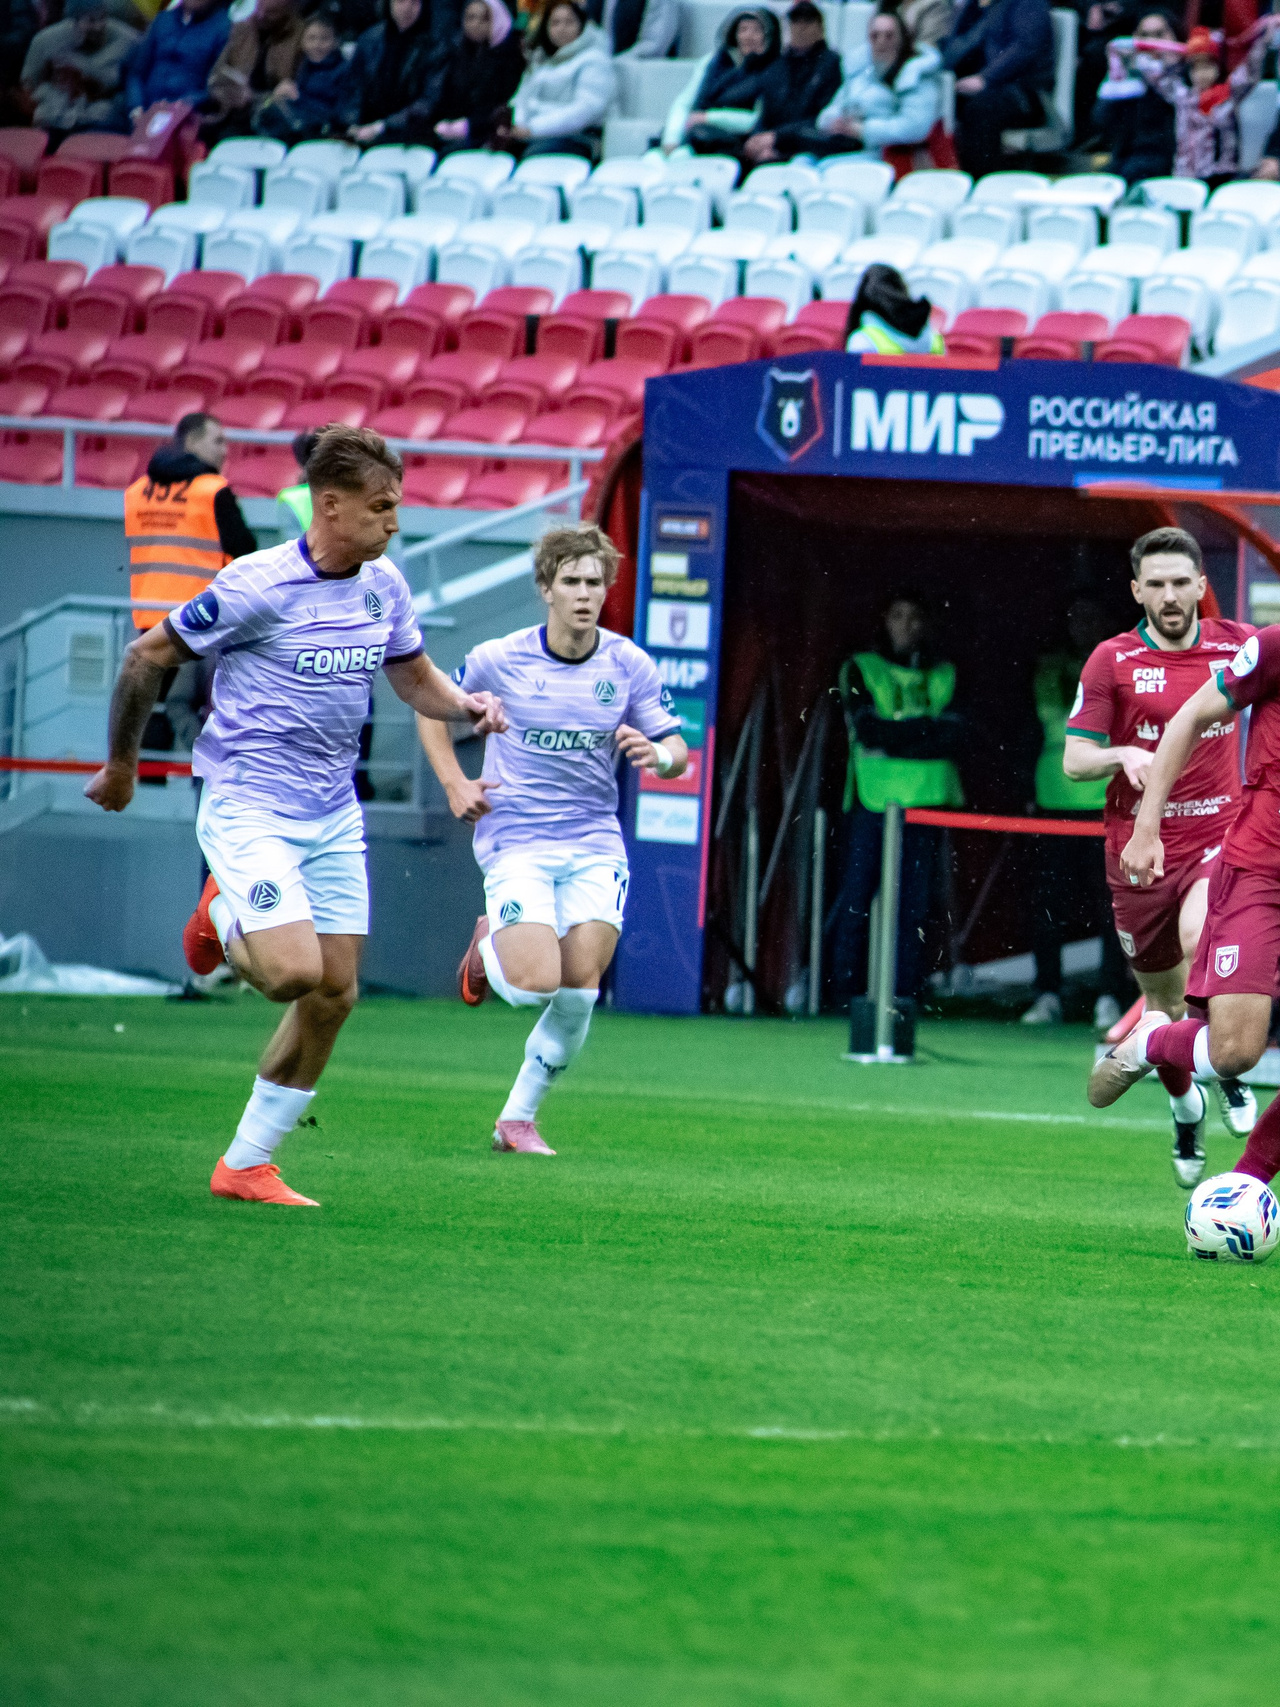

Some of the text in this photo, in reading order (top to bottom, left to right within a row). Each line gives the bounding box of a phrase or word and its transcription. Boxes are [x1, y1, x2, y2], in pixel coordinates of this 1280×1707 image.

[851, 388, 1006, 456] МИР
[1029, 391, 1217, 431] РОССИЙСКАЯ
[1028, 429, 1239, 467] ПРЕМЬЕР-ЛИГА
[1132, 667, 1165, 681] FON
[1135, 680, 1168, 694] BET
